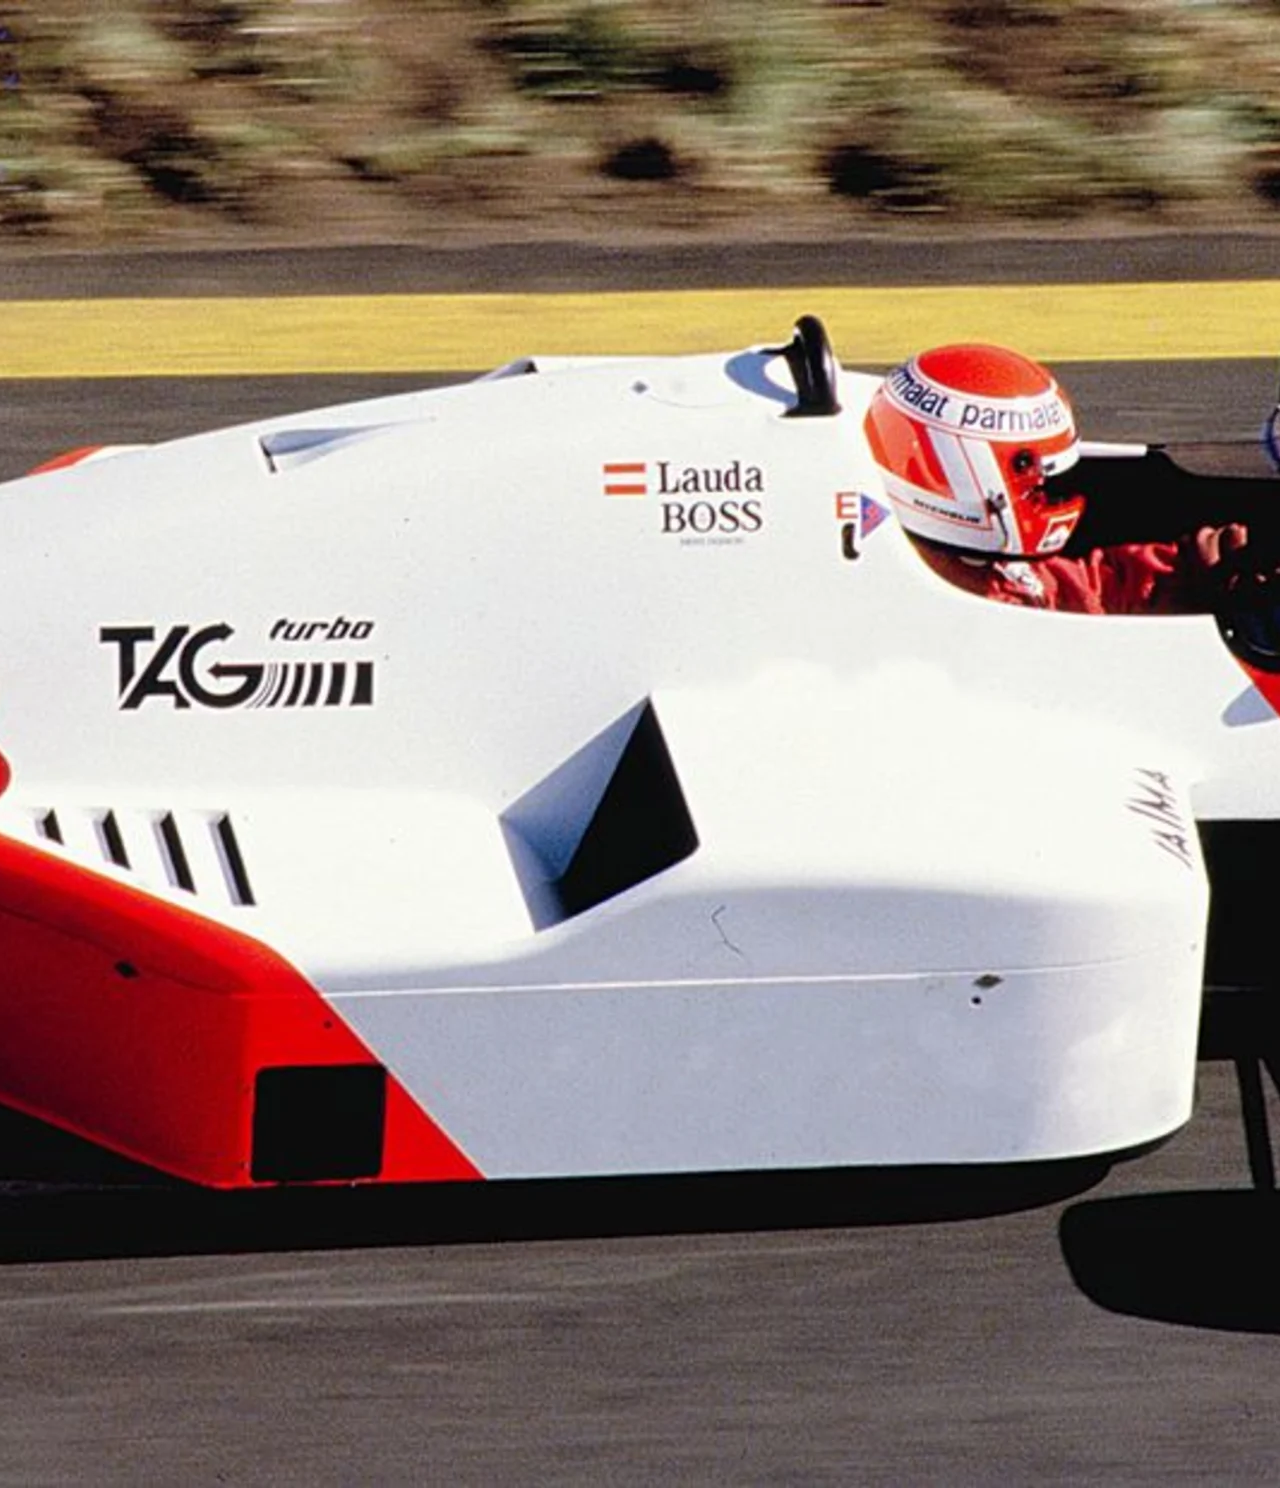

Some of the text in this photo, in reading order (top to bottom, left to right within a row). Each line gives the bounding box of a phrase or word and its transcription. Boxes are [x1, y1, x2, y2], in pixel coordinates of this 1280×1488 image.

[657, 460, 764, 495] Lauda
[661, 500, 763, 533] BOSS
[269, 616, 375, 641] turbo
[99, 622, 266, 710] TAG
